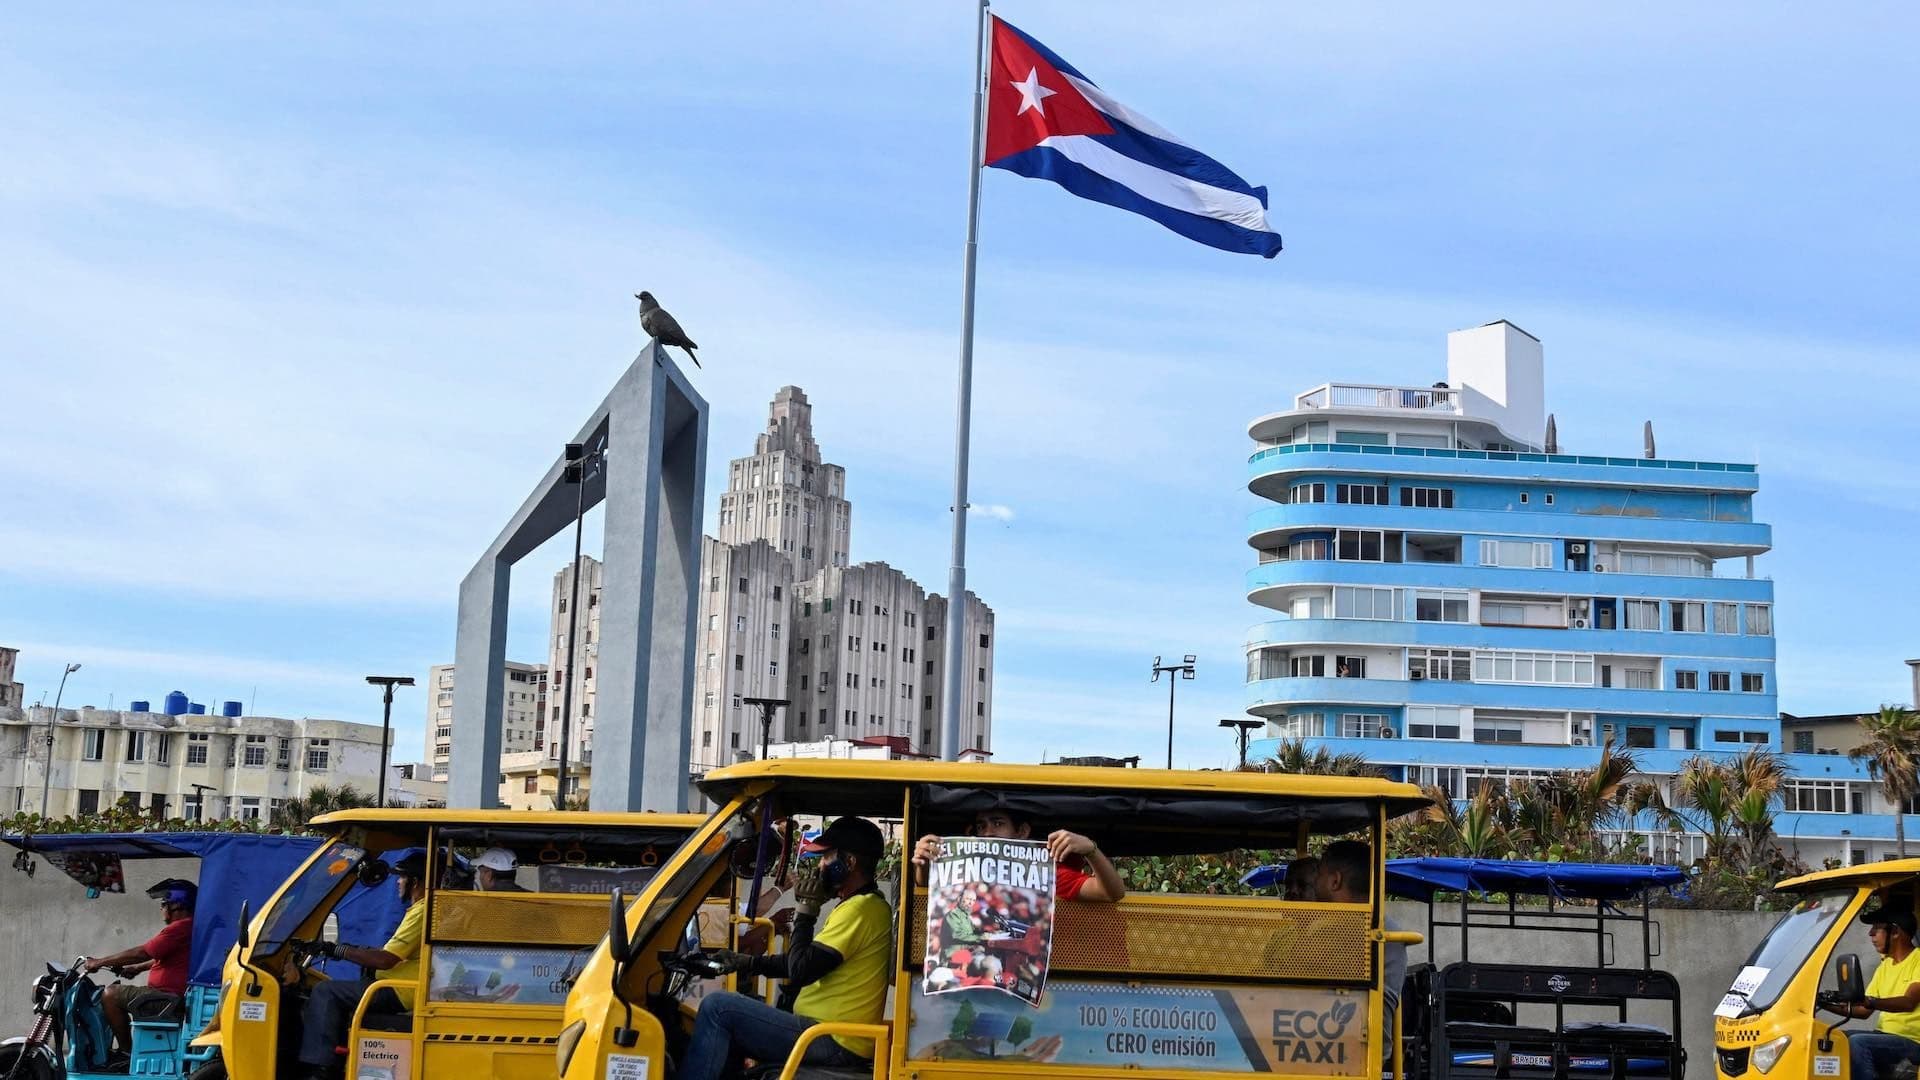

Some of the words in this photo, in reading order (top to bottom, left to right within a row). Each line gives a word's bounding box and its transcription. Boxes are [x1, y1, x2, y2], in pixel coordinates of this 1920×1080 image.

[956, 841, 1000, 856] PUEBLO
[1003, 844, 1049, 863] CUBANO
[937, 857, 1049, 892] VENCERÁ!
[532, 965, 550, 977] 100
[549, 981, 571, 993] CER
[1079, 1006, 1107, 1027] 100
[1112, 1007, 1127, 1028] %
[1132, 1006, 1217, 1032] ECOLÓGICO
[1273, 1009, 1345, 1040] ECO
[1106, 1032, 1147, 1054] CERO
[1151, 1035, 1216, 1057] emisión
[1272, 1039, 1345, 1064] TAXI
